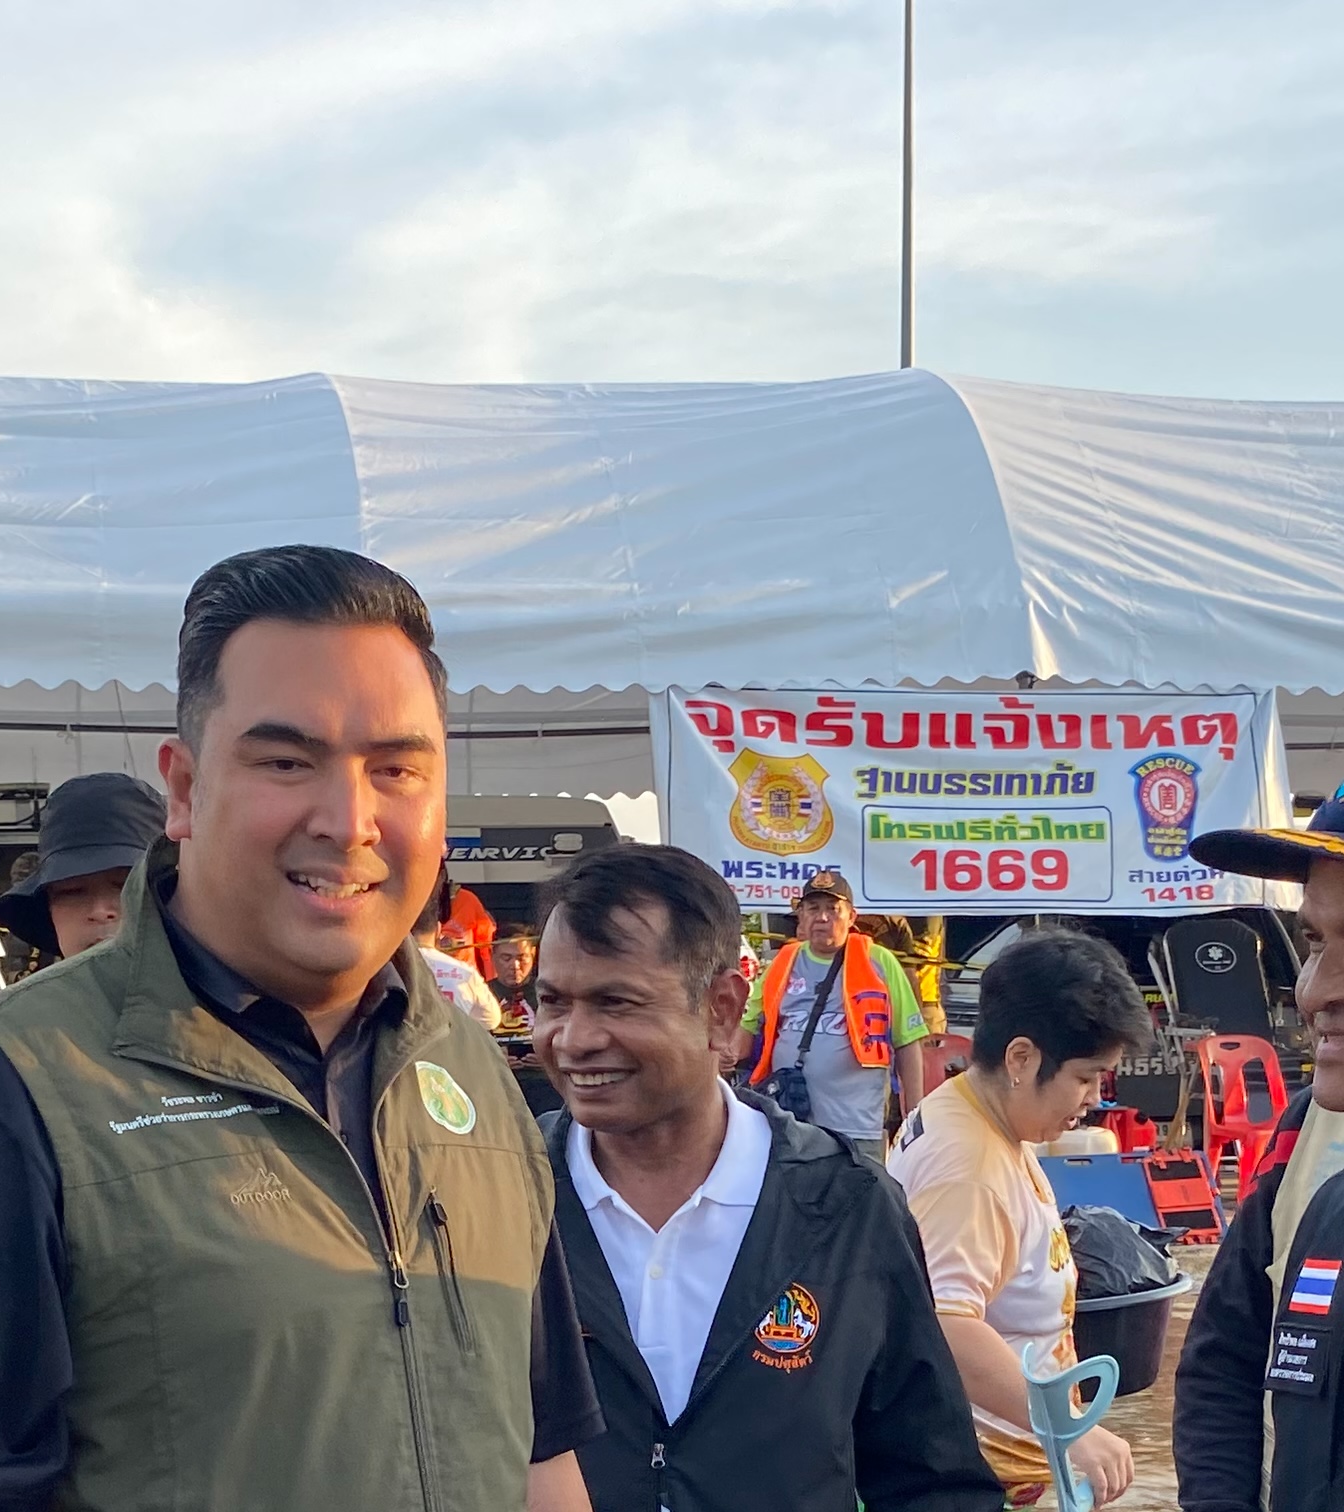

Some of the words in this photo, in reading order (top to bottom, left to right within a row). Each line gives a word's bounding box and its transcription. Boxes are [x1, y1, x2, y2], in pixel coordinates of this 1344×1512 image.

[685, 696, 1238, 760] จุดรับแจ้งเหตุ
[856, 762, 1096, 799] ฐานบรรเทาภัย
[1135, 757, 1196, 778] RESCUE
[869, 814, 1106, 841] โทรฟรีทั่วไทย
[910, 849, 1069, 892] 1669
[1141, 885, 1215, 902] 1418
[230, 1188, 291, 1206] OUTDOOR
